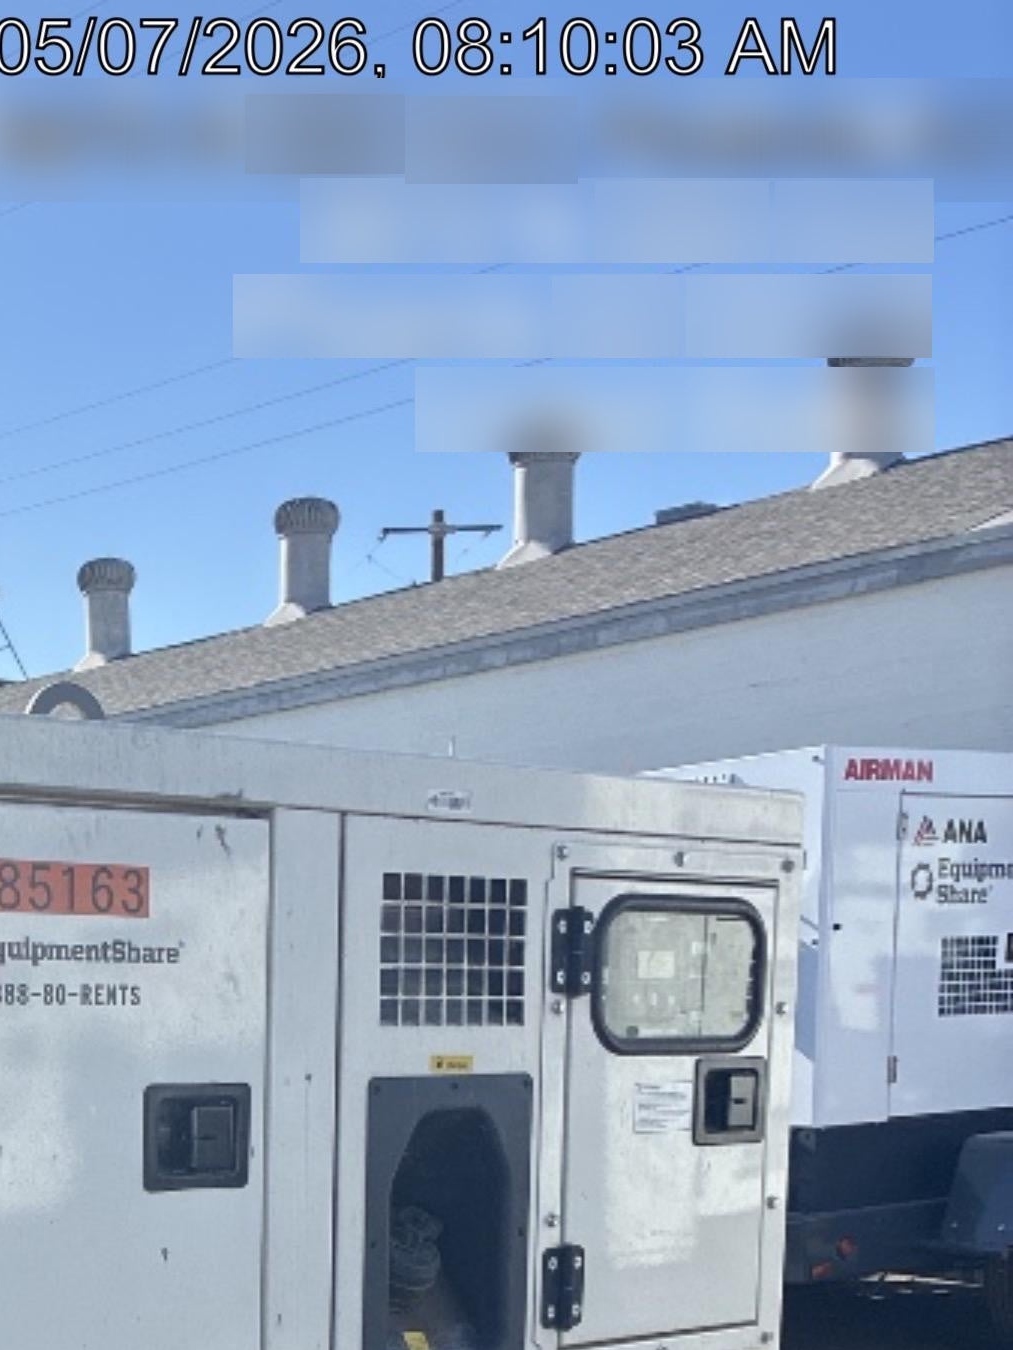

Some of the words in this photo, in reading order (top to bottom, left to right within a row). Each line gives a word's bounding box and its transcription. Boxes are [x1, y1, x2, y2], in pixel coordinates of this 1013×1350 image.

[844, 758, 934, 782] AIRMAN
[942, 817, 988, 844] ANA
[936, 884, 988, 904] Share
